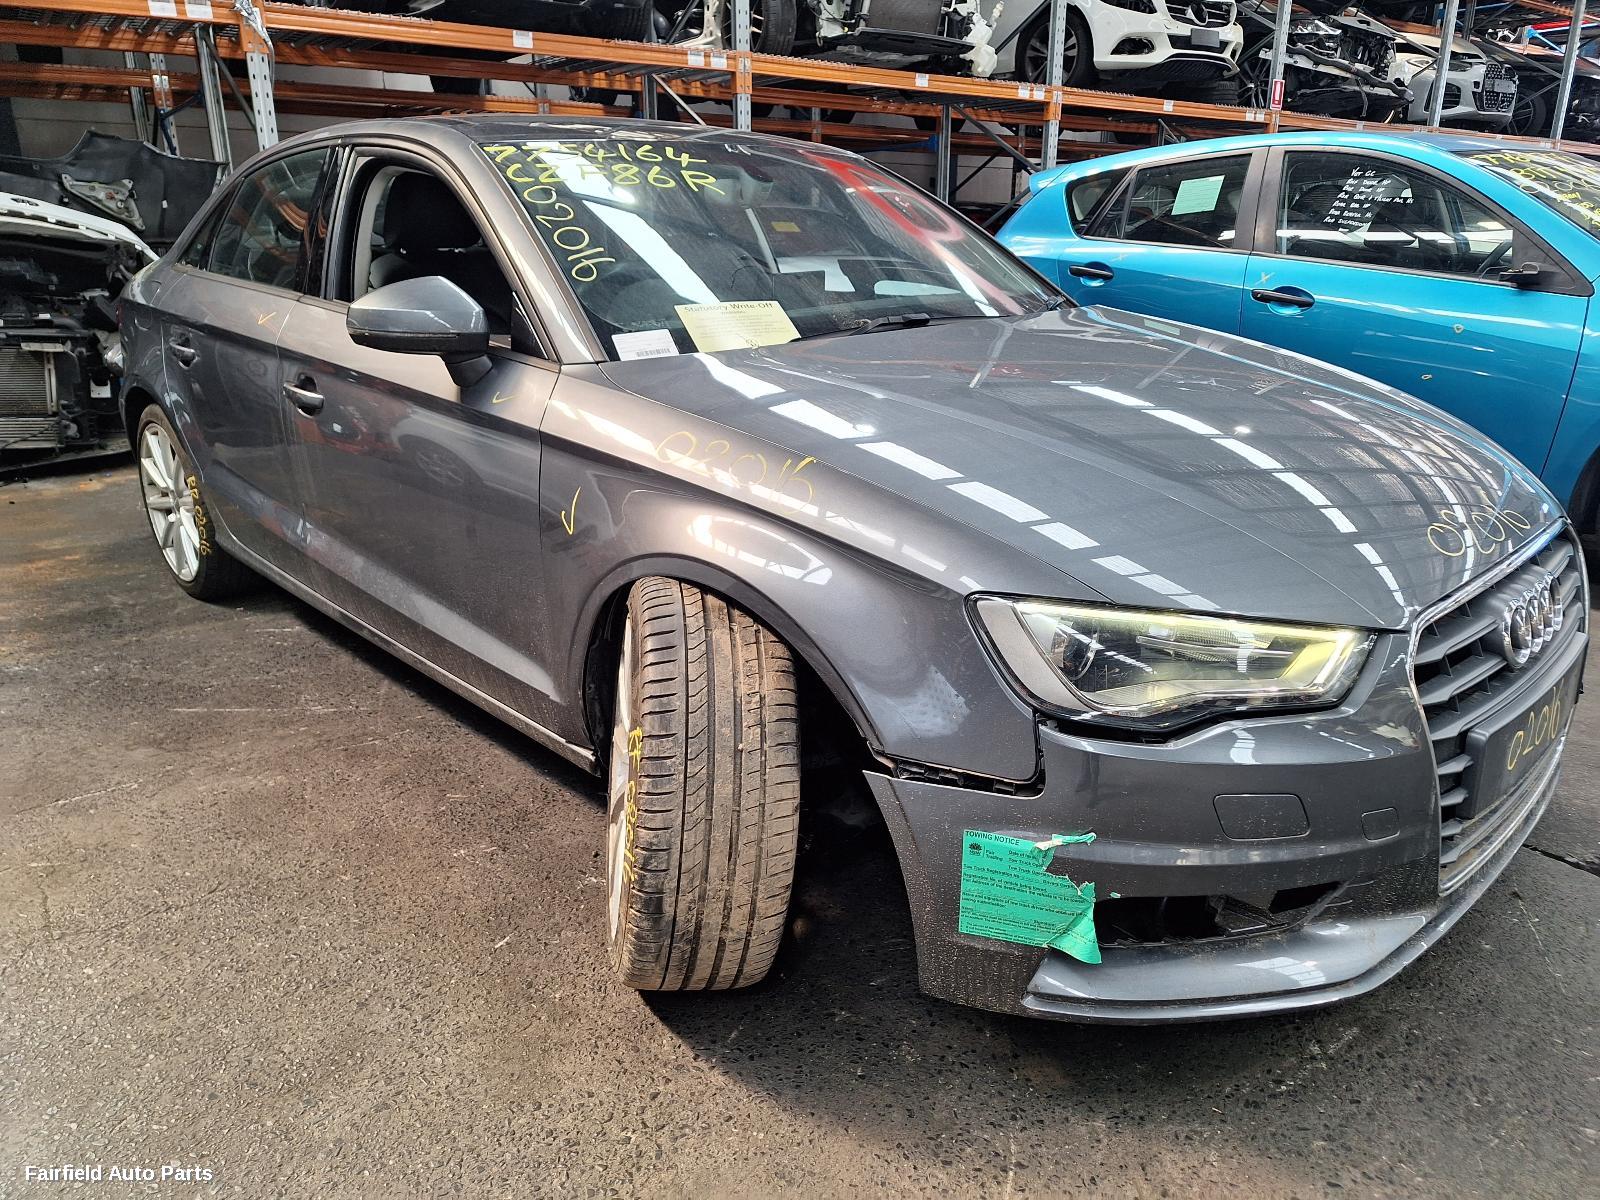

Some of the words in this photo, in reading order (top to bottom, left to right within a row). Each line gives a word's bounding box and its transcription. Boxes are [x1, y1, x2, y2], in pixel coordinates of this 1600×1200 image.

[523, 185, 615, 282] 02016
[729, 302, 773, 311] Write-Off
[965, 831, 993, 841] TOWING
[994, 835, 1020, 846] NOTICE
